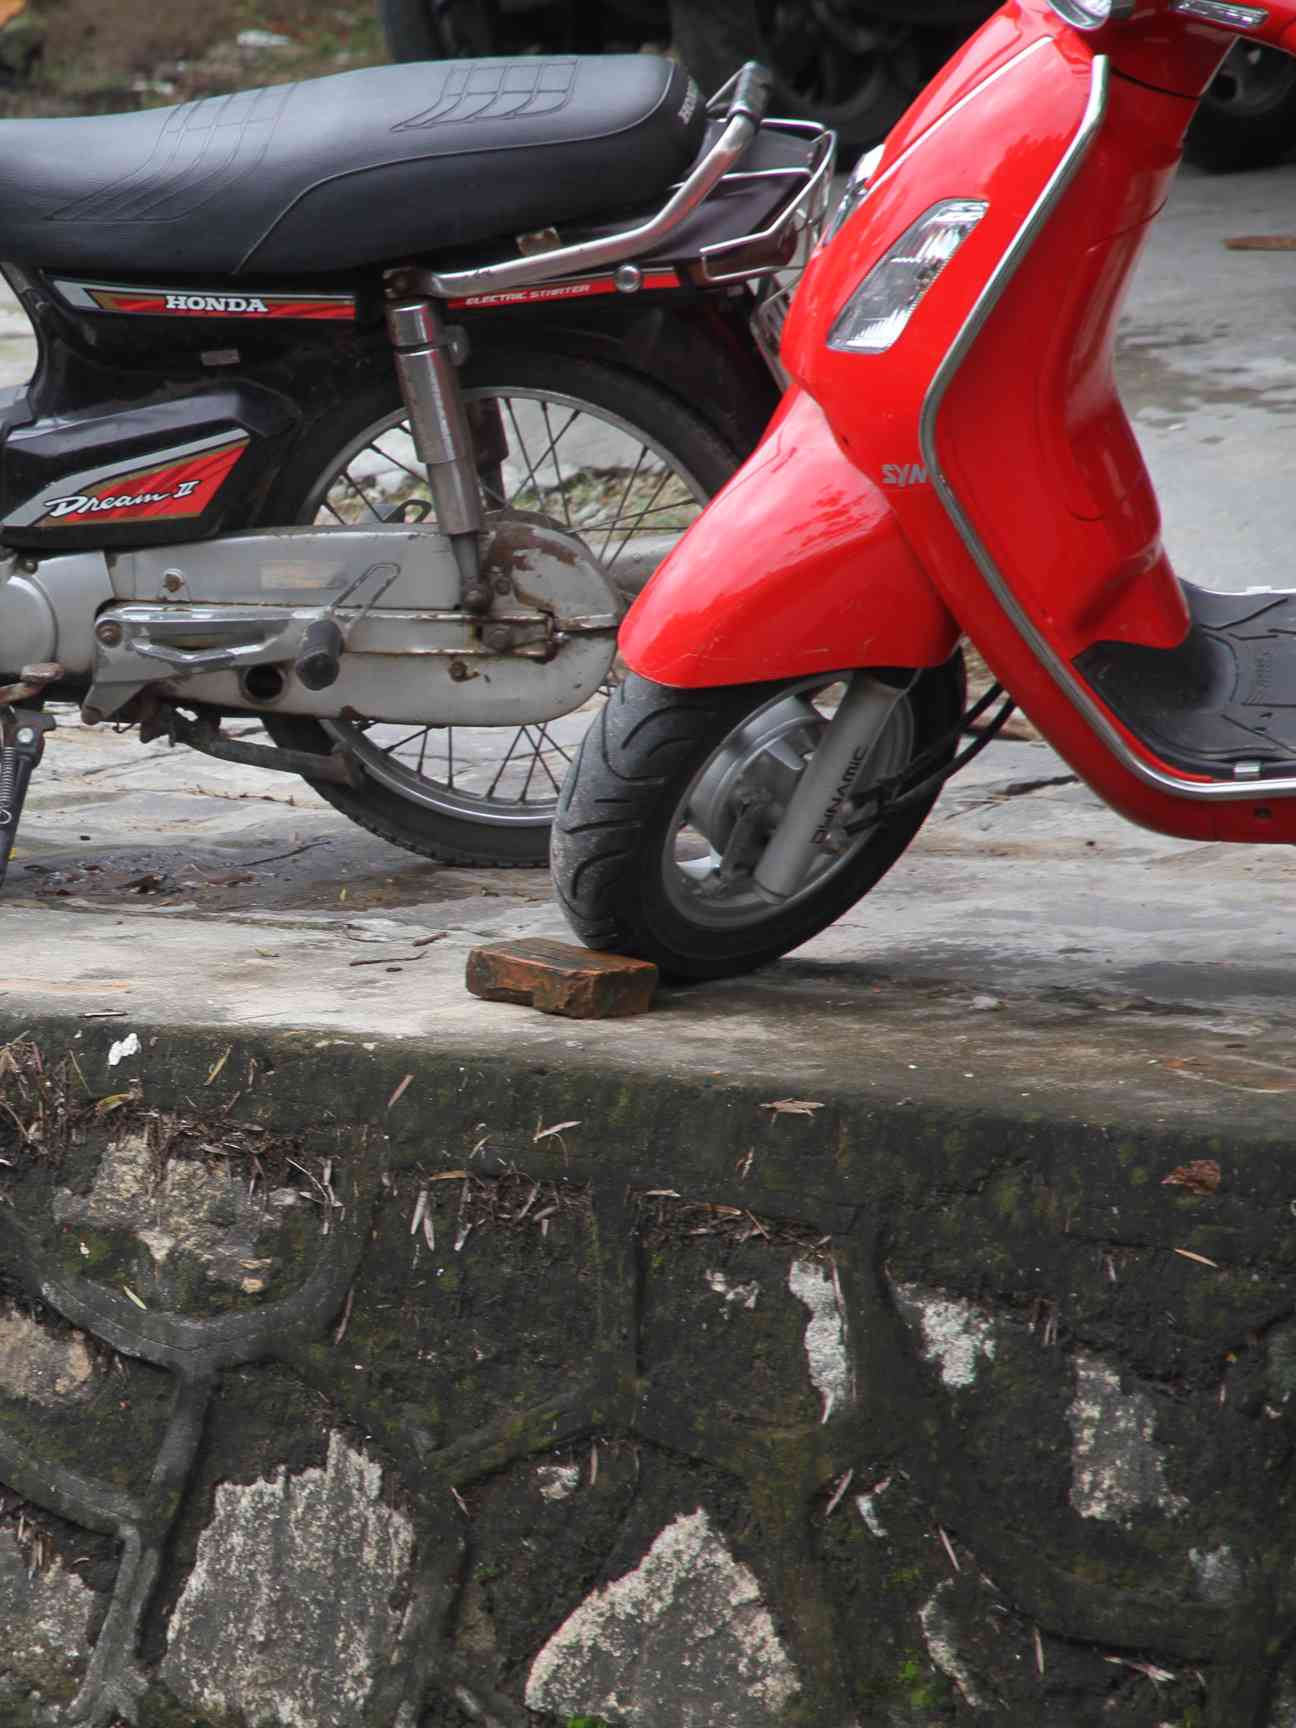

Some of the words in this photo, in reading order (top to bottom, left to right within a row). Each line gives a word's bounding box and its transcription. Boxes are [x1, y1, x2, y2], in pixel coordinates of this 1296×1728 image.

[165, 295, 269, 313] HONDA
[464, 289, 528, 306] ELECTRIC
[529, 283, 591, 300] STARTER
[45, 491, 171, 517] Dream
